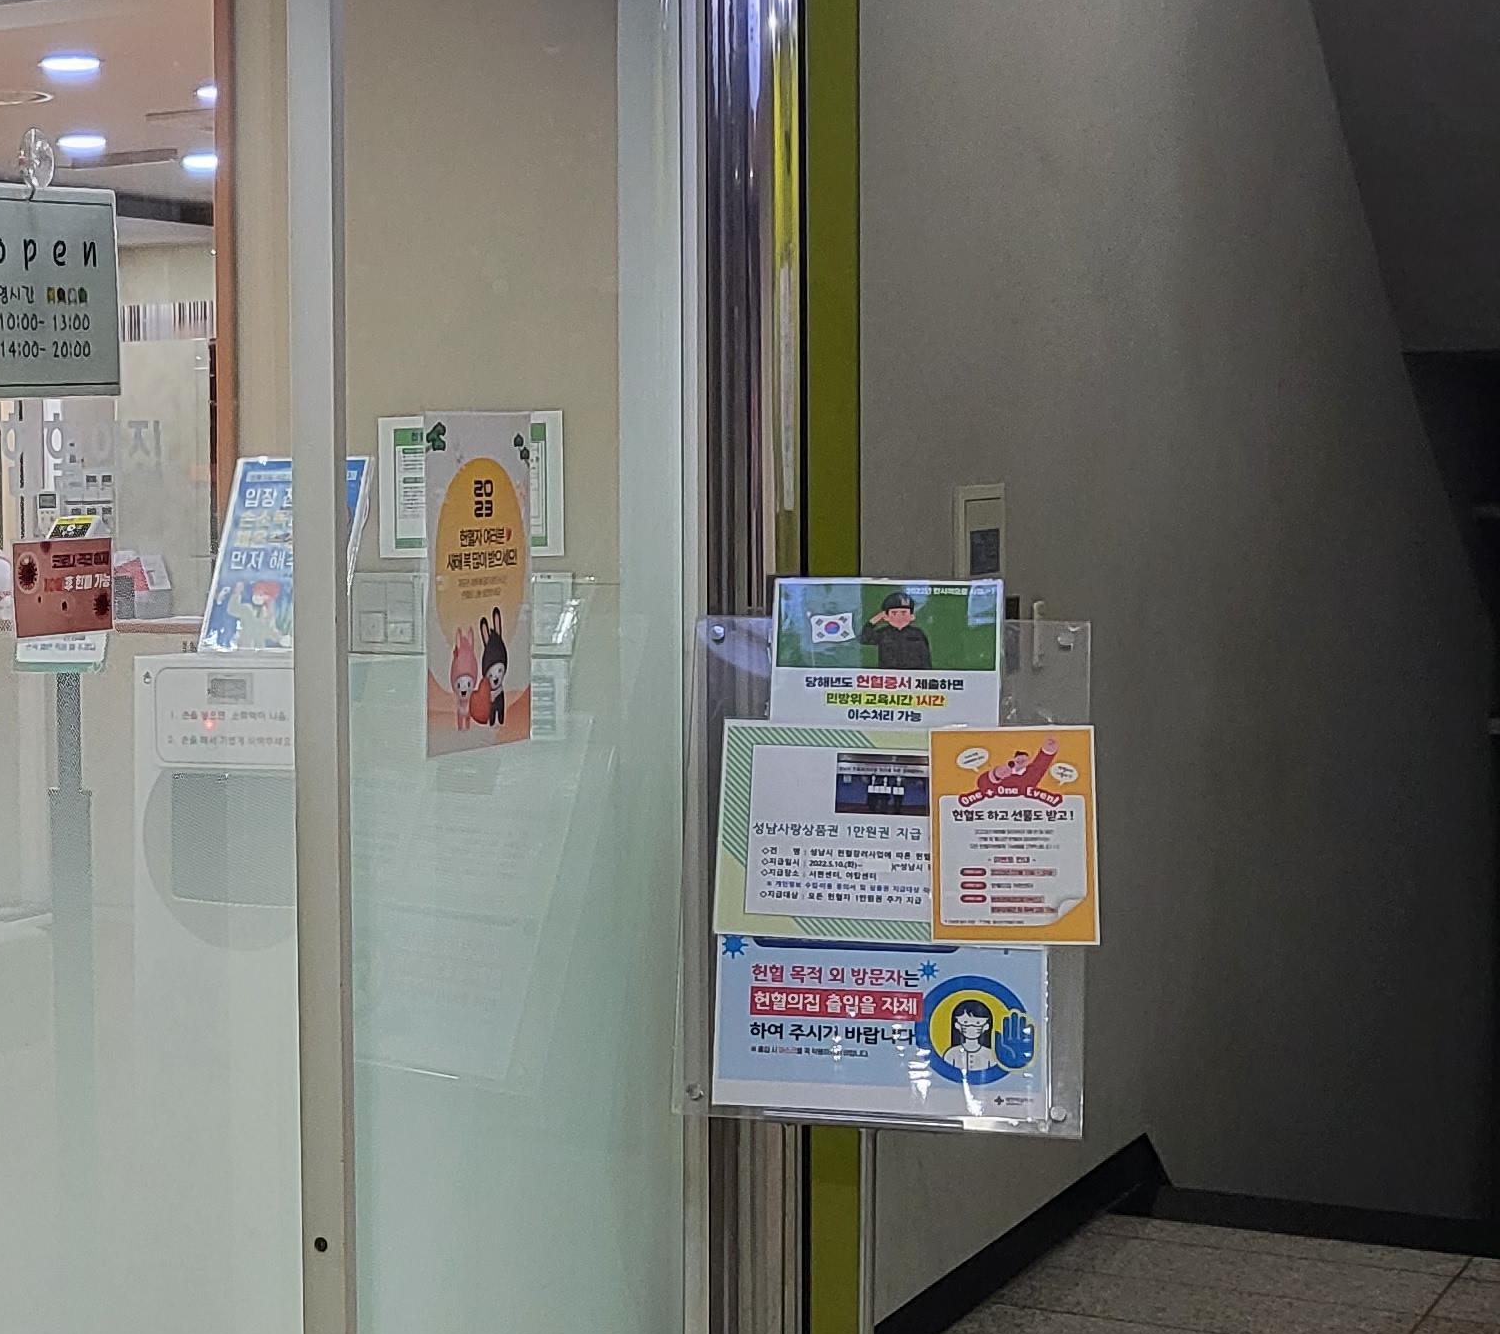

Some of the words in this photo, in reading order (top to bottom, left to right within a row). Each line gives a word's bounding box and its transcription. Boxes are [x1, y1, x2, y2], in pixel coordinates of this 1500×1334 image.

[52, 313, 91, 332] 13:00
[52, 339, 92, 358] 20:00
[244, 487, 278, 508] 입장
[473, 479, 494, 498] 20
[474, 499, 494, 518] 23
[230, 550, 264, 570] 먼저
[805, 676, 853, 688] 당해년도
[856, 674, 911, 689] 헌혈증서
[914, 677, 964, 691] 제출하면
[826, 692, 862, 705] 민방위
[864, 693, 913, 706] 교육시간
[915, 694, 945, 707] 1시간
[847, 708, 894, 721] 이수처리
[897, 709, 922, 723] 가능
[961, 792, 983, 806] One
[997, 785, 1019, 795] One
[1026, 786, 1060, 806] Event
[951, 809, 986, 822] 헌혈도
[987, 809, 1010, 822] 하고
[1011, 809, 1044, 822] 선물도
[752, 822, 839, 838] 성남사랑상품권
[846, 825, 890, 840] 1만원권
[896, 827, 922, 841] 지급
[752, 963, 784, 983] 헌혈
[790, 965, 823, 985] 목적
[828, 967, 845, 984] 외
[851, 967, 921, 988] 방문자는
[754, 991, 820, 1011] 헌혈의집
[825, 993, 876, 1015] 출입을
[881, 996, 917, 1016] 자제
[750, 1021, 784, 1040] 하여
[789, 1024, 840, 1042] 주시기
[845, 1025, 915, 1045] 바랍니다
